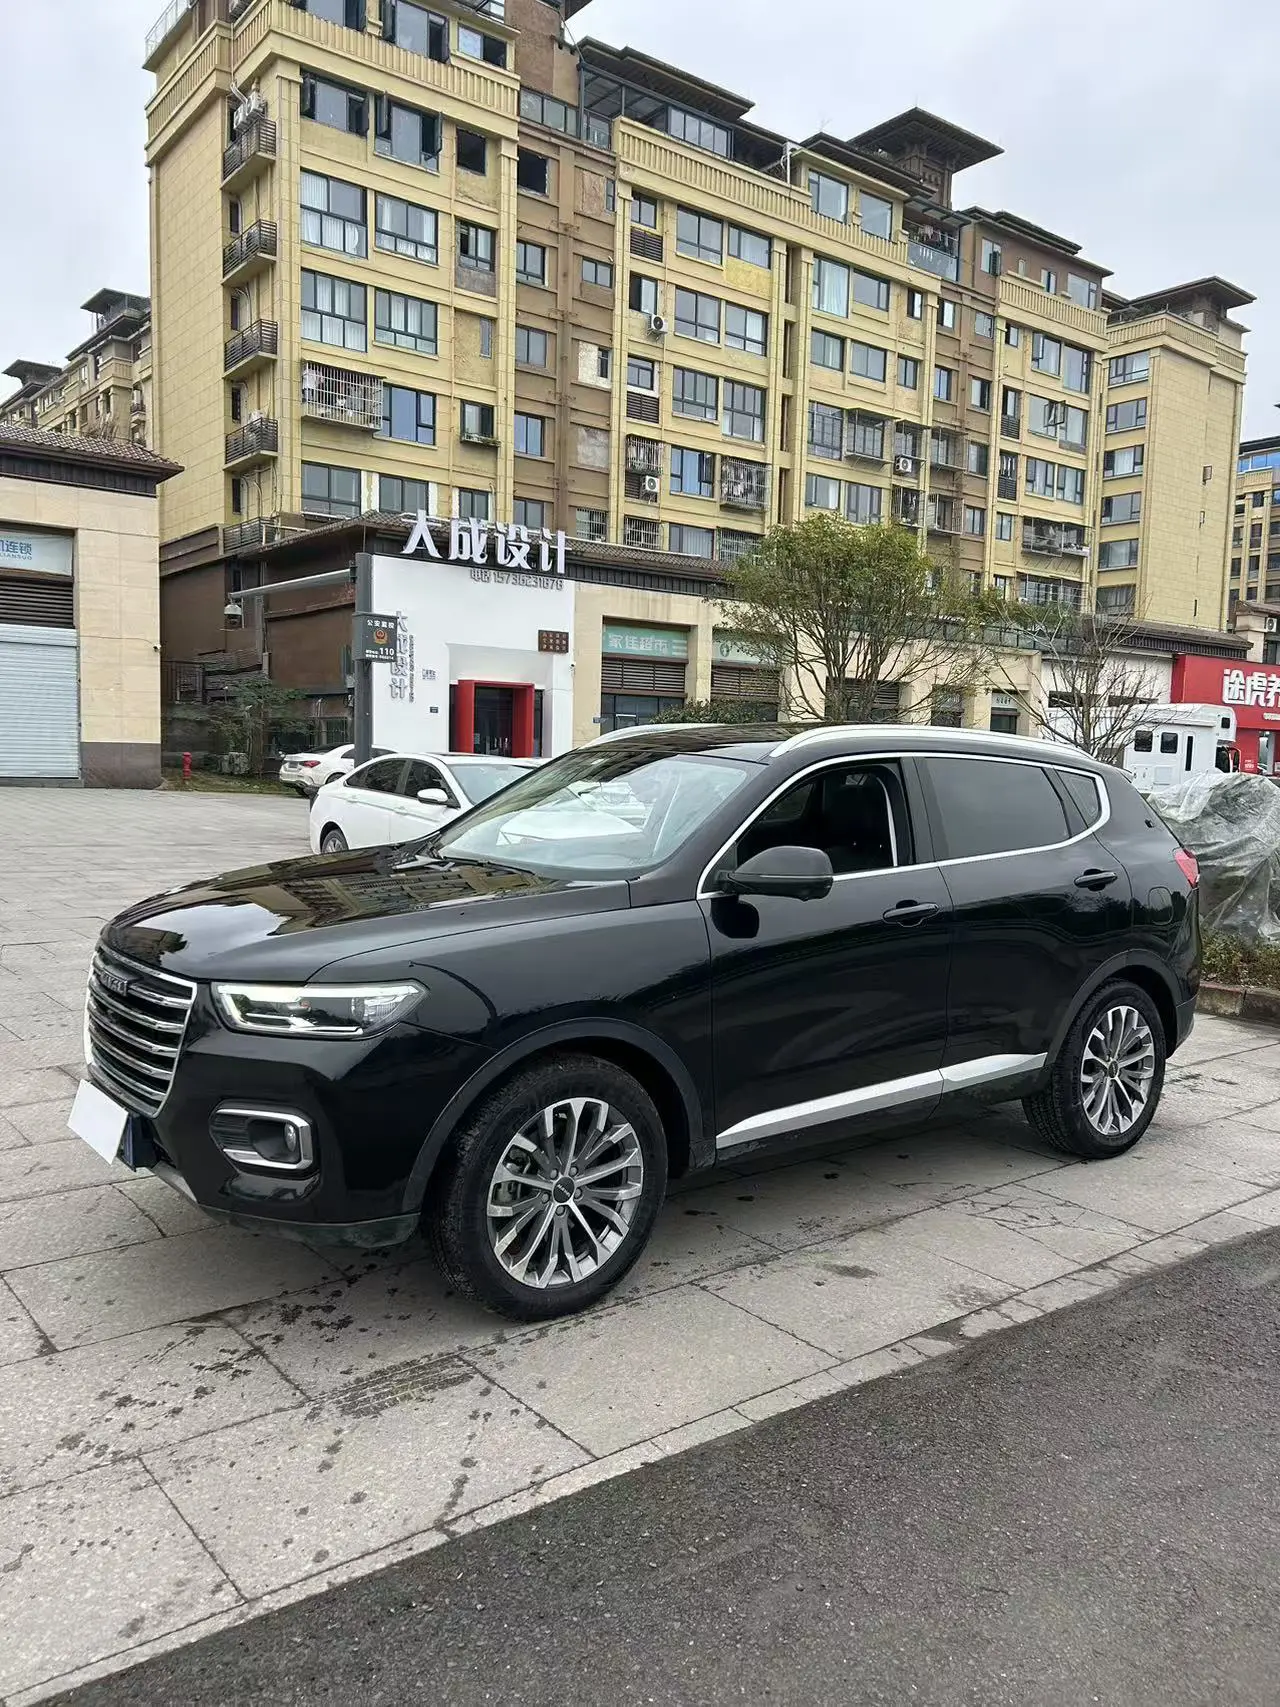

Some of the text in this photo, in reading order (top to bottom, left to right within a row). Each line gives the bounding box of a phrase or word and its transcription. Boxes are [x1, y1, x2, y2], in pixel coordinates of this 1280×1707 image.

[400, 508, 572, 574] 大成设计
[379, 647, 395, 656] 110
